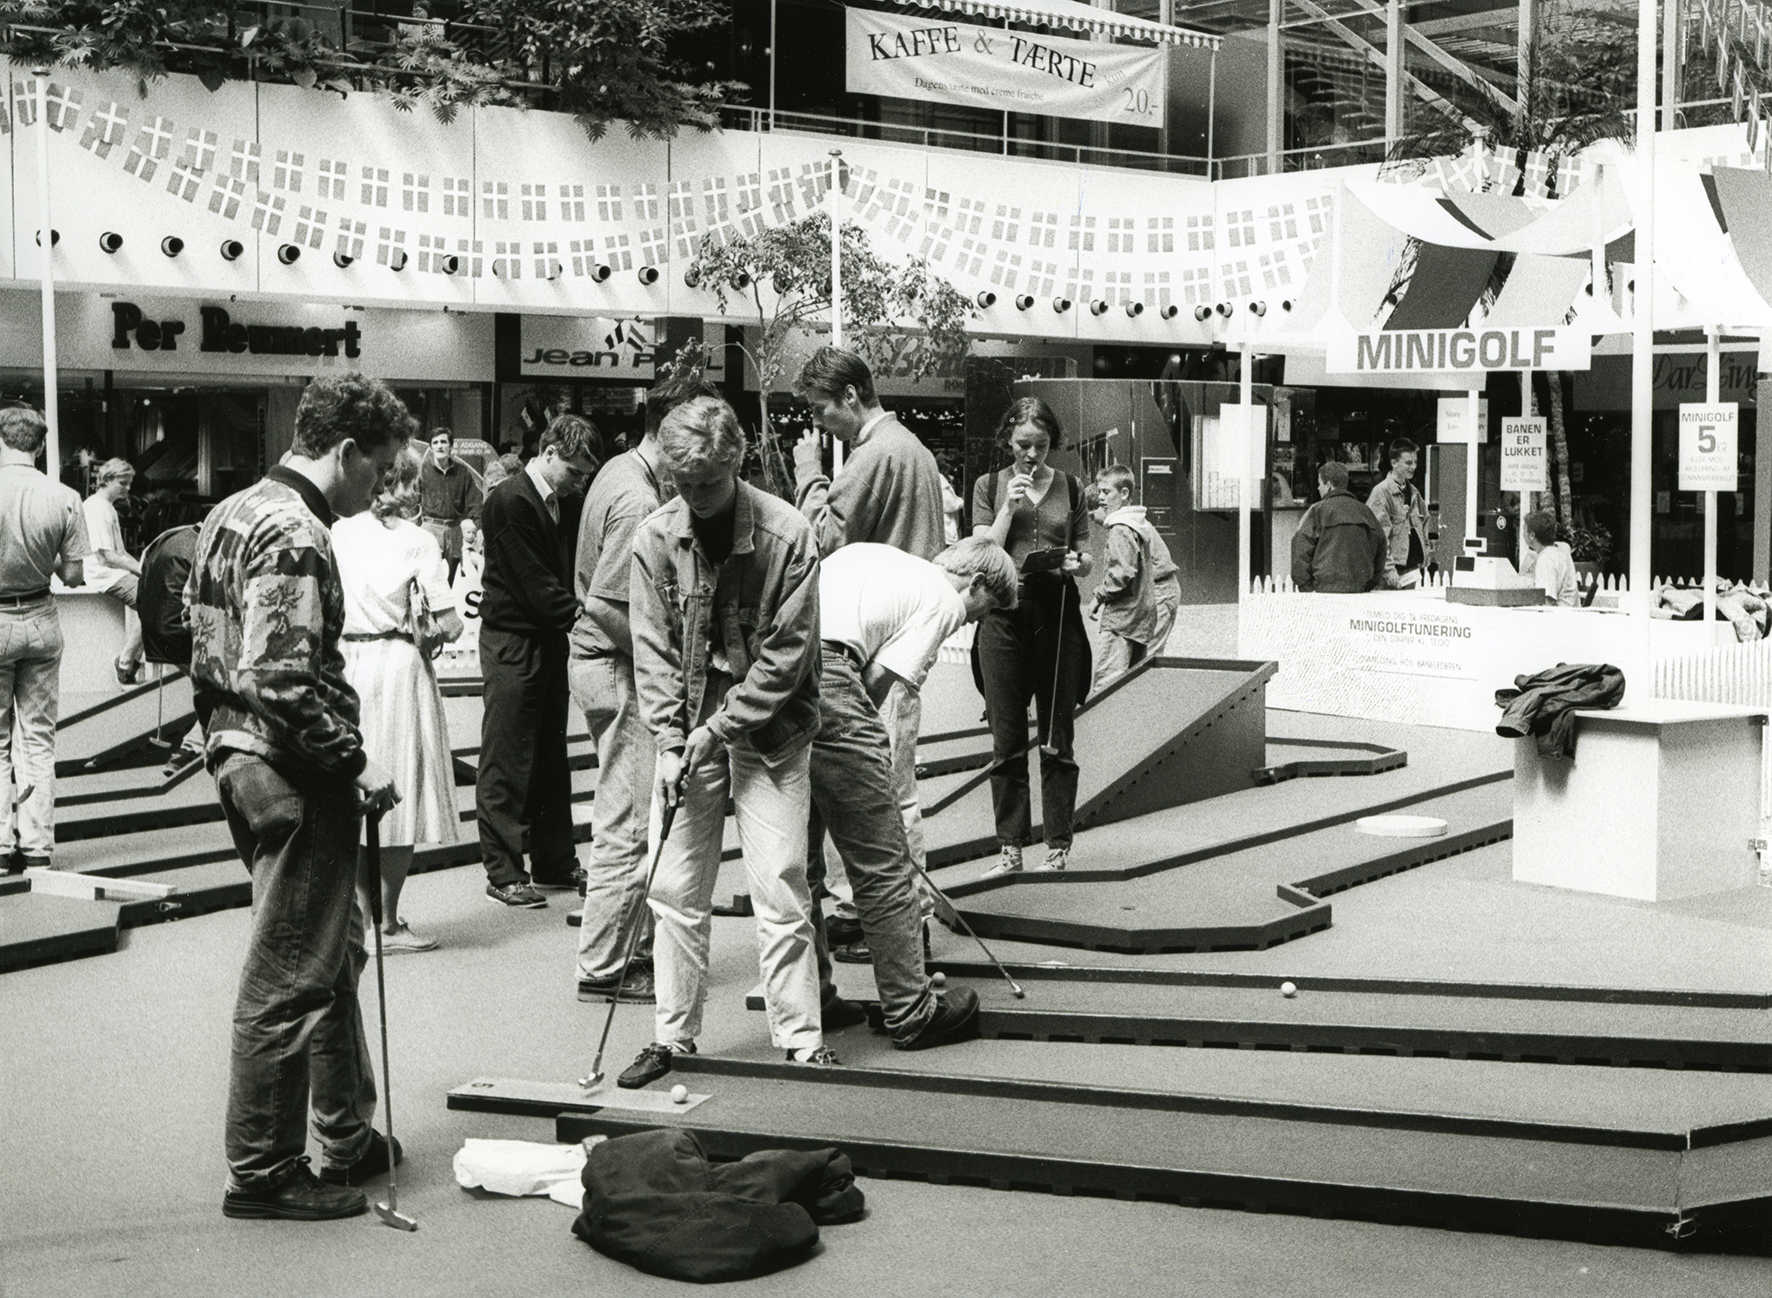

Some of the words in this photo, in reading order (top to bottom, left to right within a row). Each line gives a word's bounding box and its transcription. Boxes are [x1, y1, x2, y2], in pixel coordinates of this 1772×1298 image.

[868, 26, 961, 61] KAFFE
[974, 29, 994, 56] &
[1009, 35, 1097, 89] TÆRTE
[111, 302, 186, 351] Per
[1356, 329, 1556, 370] MINIGOLF
[1681, 412, 1735, 423] MINIGOLF
[1506, 424, 1542, 434] BANEN
[1516, 435, 1530, 445] ER
[1697, 425, 1716, 454] 5
[1504, 447, 1543, 457] LUKKET
[1349, 619, 1472, 639] MINIGOLFTUNERING
